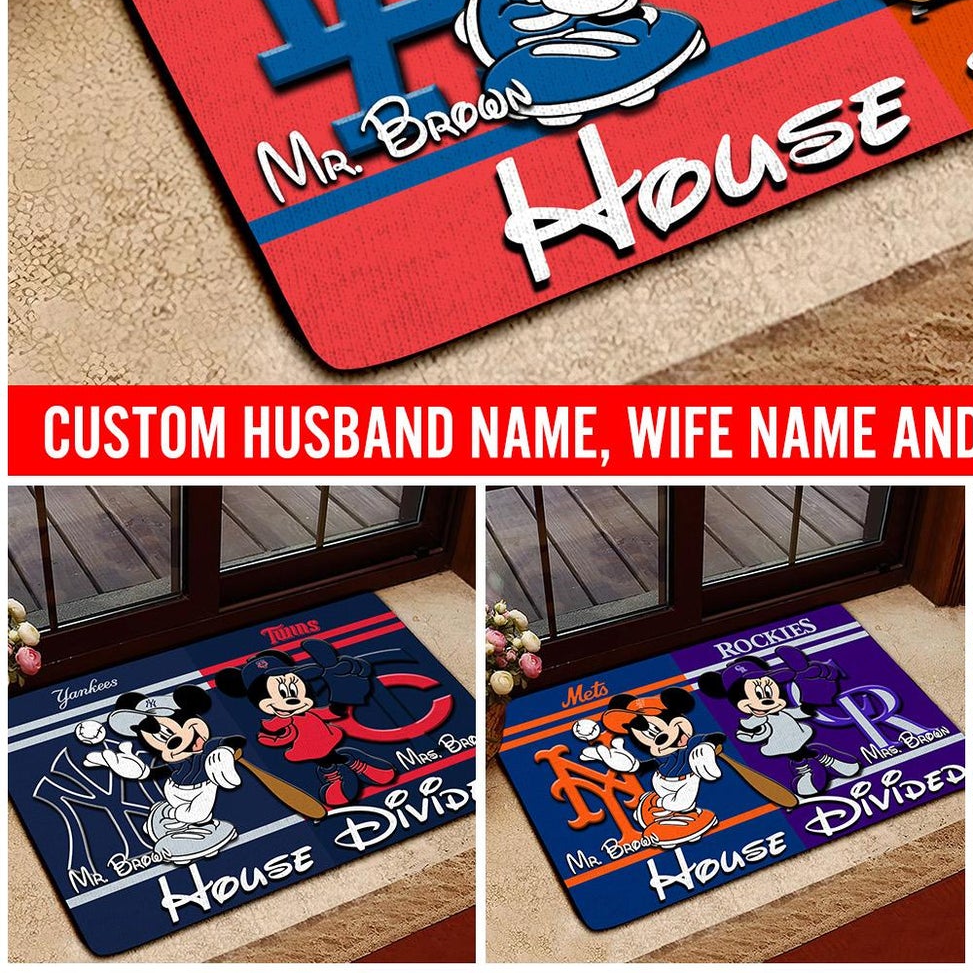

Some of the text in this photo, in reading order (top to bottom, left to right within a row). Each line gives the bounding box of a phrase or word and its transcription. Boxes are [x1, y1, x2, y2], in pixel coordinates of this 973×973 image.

[496, 77, 913, 284] HOUSE
[260, 619, 321, 645] Twins
[713, 617, 818, 659] ROCKIES
[51, 677, 118, 710] Yankees
[561, 680, 608, 710] Mets
[157, 845, 316, 924] HOUSE
[647, 831, 788, 903] HOUSE
